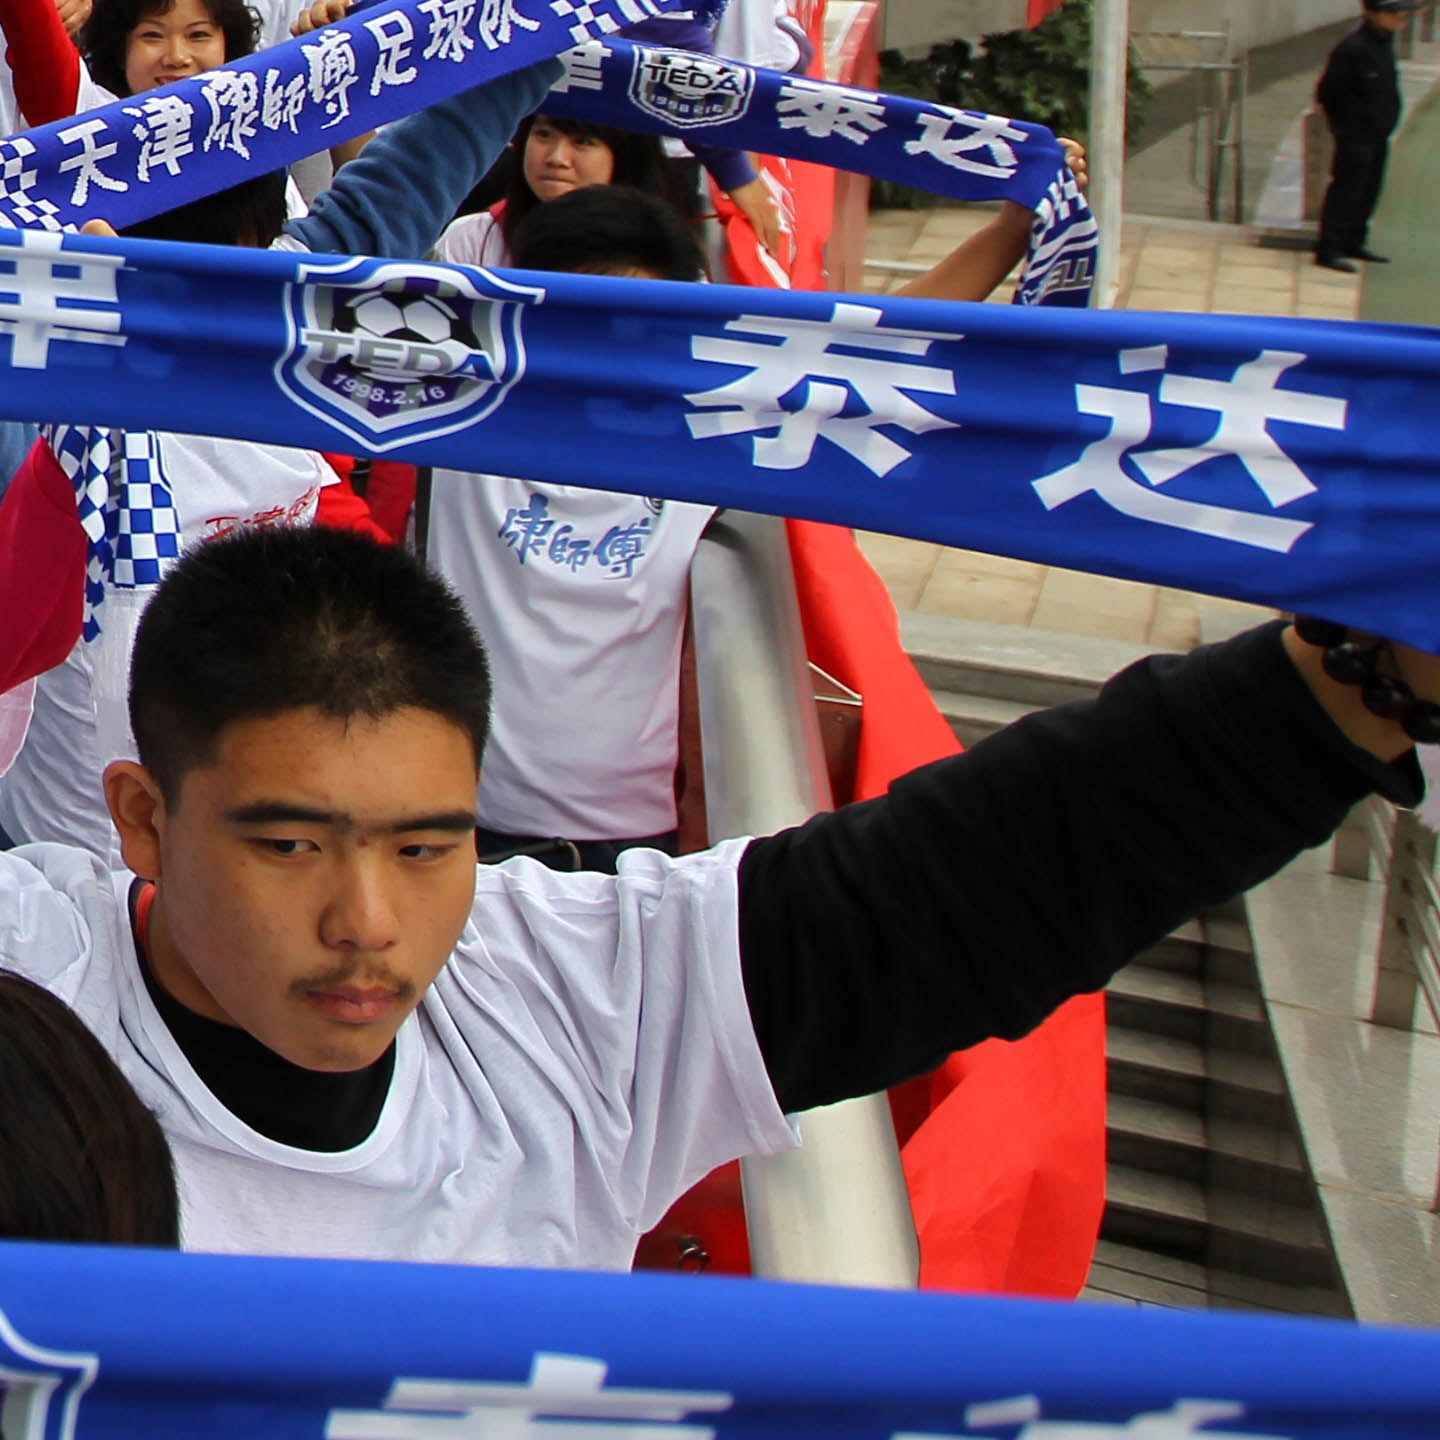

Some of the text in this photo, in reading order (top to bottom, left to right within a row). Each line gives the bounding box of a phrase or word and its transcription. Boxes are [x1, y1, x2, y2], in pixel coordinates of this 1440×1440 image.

[645, 62, 743, 95] TEDA
[776, 75, 1029, 180] 泰达
[301, 327, 502, 384] TEDA
[332, 373, 446, 406] 1998.2.16
[685, 303, 1348, 554] 泰达
